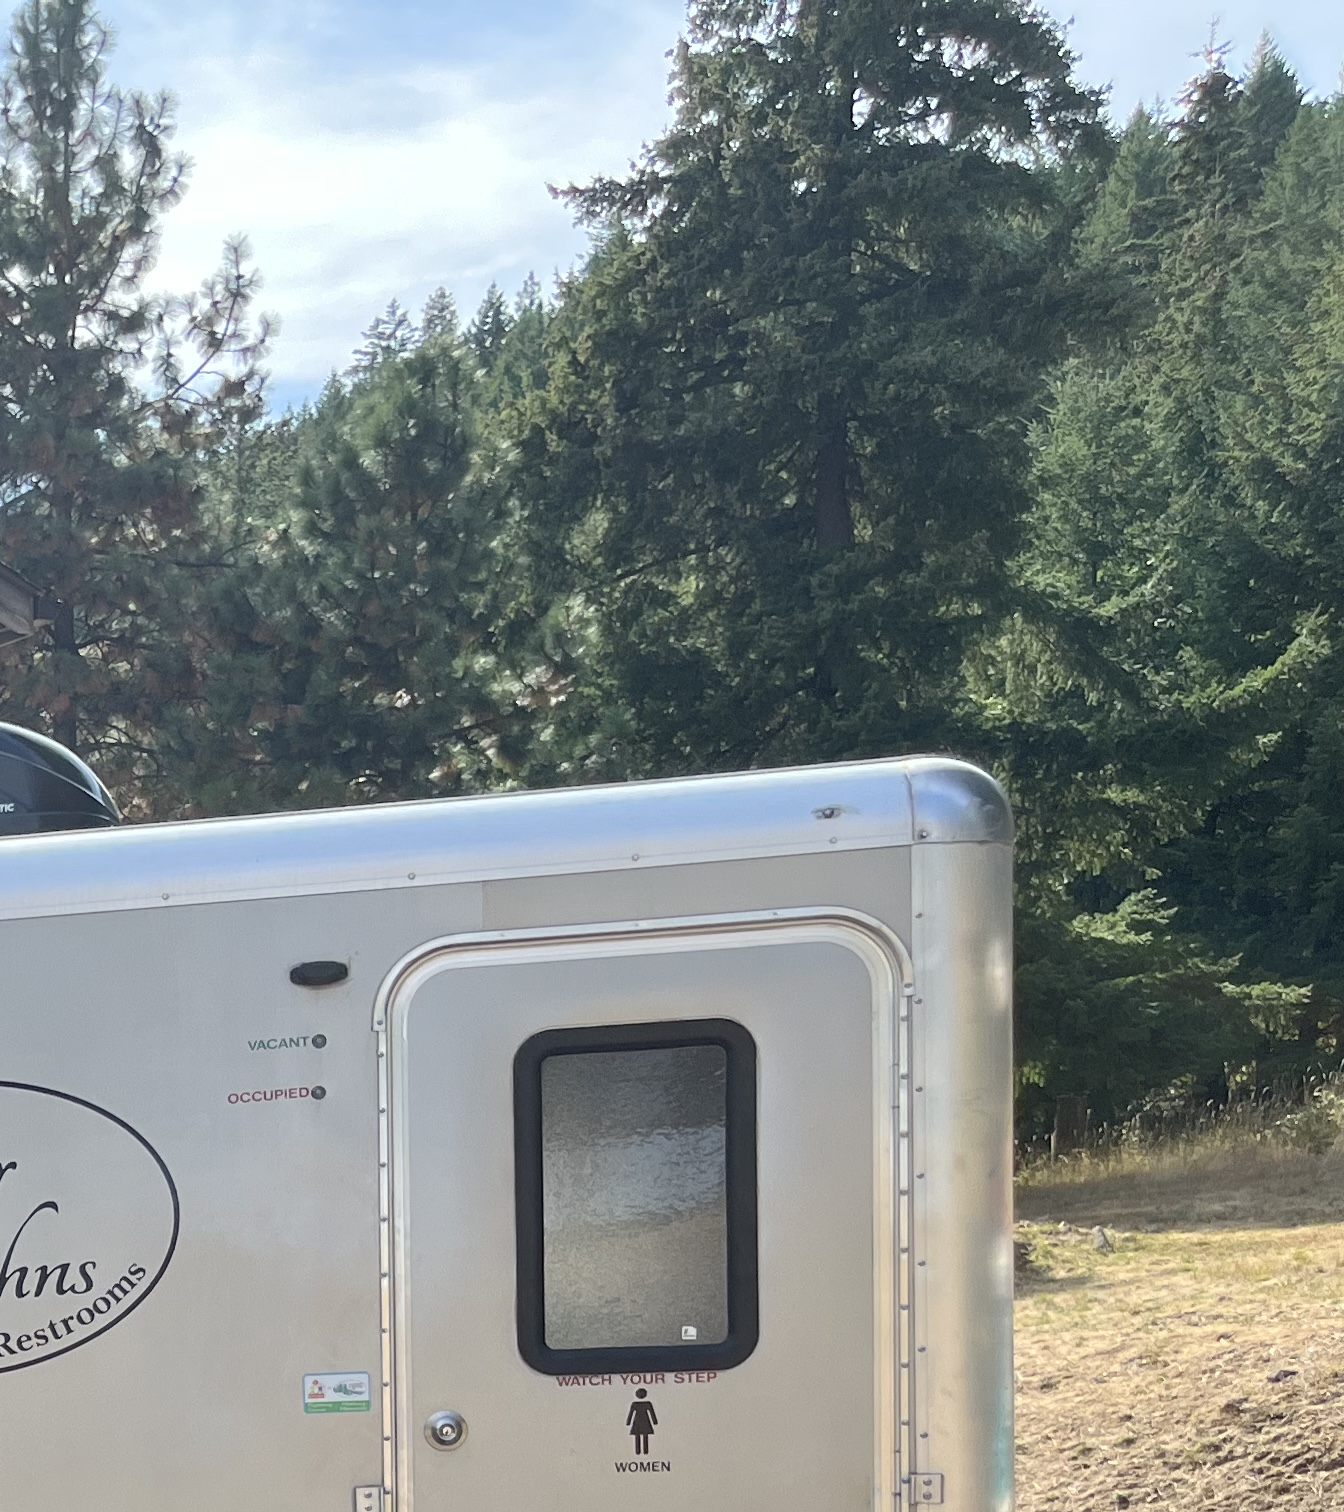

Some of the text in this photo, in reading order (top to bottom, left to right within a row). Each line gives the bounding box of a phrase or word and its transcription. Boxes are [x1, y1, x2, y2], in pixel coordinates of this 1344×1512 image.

[247, 1036, 310, 1051] VACANT
[227, 1087, 310, 1104] OCCUPIED
[556, 1371, 718, 1387] WATCH YOUR STEP
[614, 1461, 671, 1473] WOMEN
